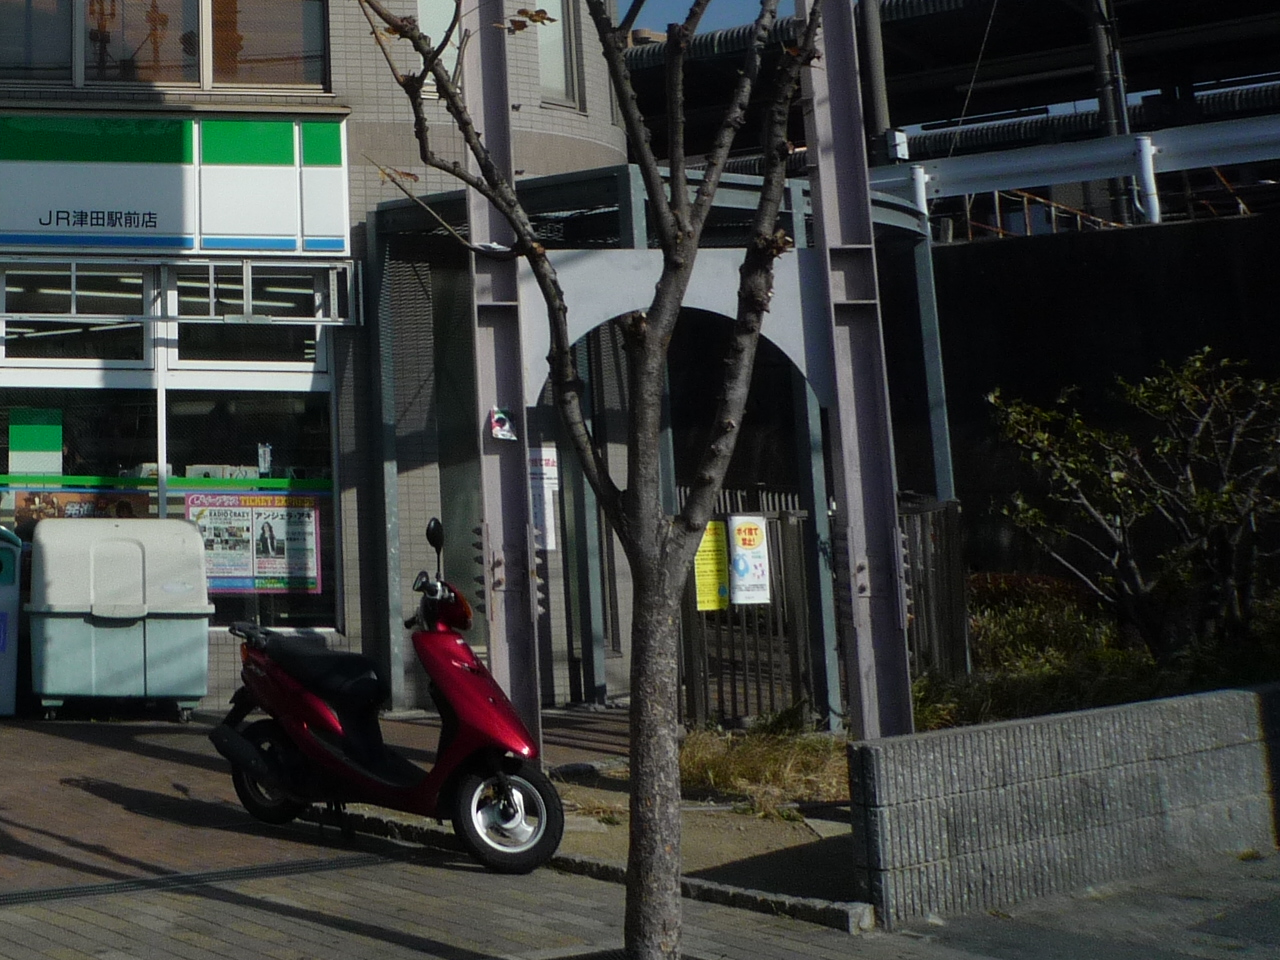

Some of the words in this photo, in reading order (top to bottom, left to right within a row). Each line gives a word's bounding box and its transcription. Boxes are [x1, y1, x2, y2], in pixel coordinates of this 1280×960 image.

[38, 209, 158, 228] JR津田駅前店
